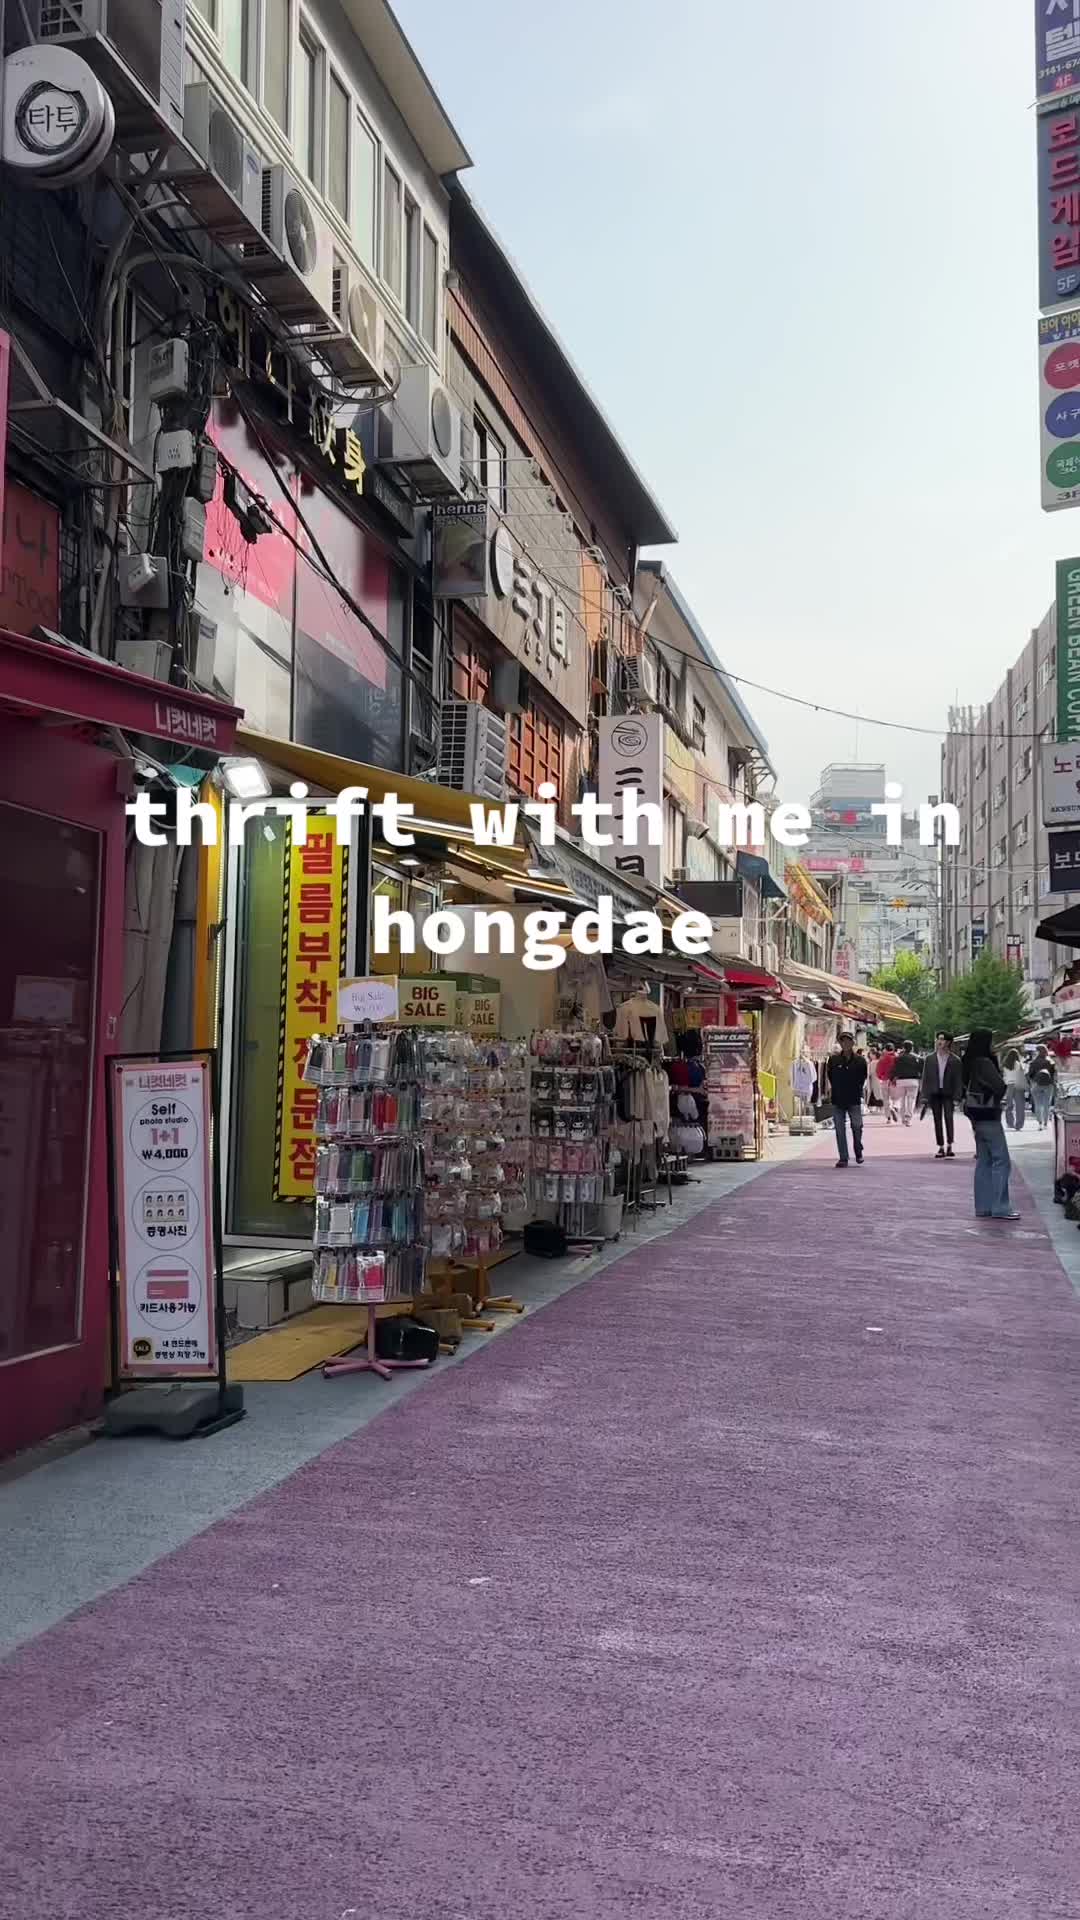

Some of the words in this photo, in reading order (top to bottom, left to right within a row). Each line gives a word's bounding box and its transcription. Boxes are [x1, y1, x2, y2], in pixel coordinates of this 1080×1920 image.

[29, 104, 77, 133] 타투
[1056, 274, 1077, 291] 5F
[437, 503, 487, 515] henna
[412, 986, 439, 1001] BIG
[404, 1003, 446, 1017] SALE
[474, 999, 490, 1011] BIG
[151, 1103, 177, 1116] Self
[139, 1117, 163, 1126] photo
[164, 1116, 189, 1124] studio
[151, 1128, 179, 1146] 1+1
